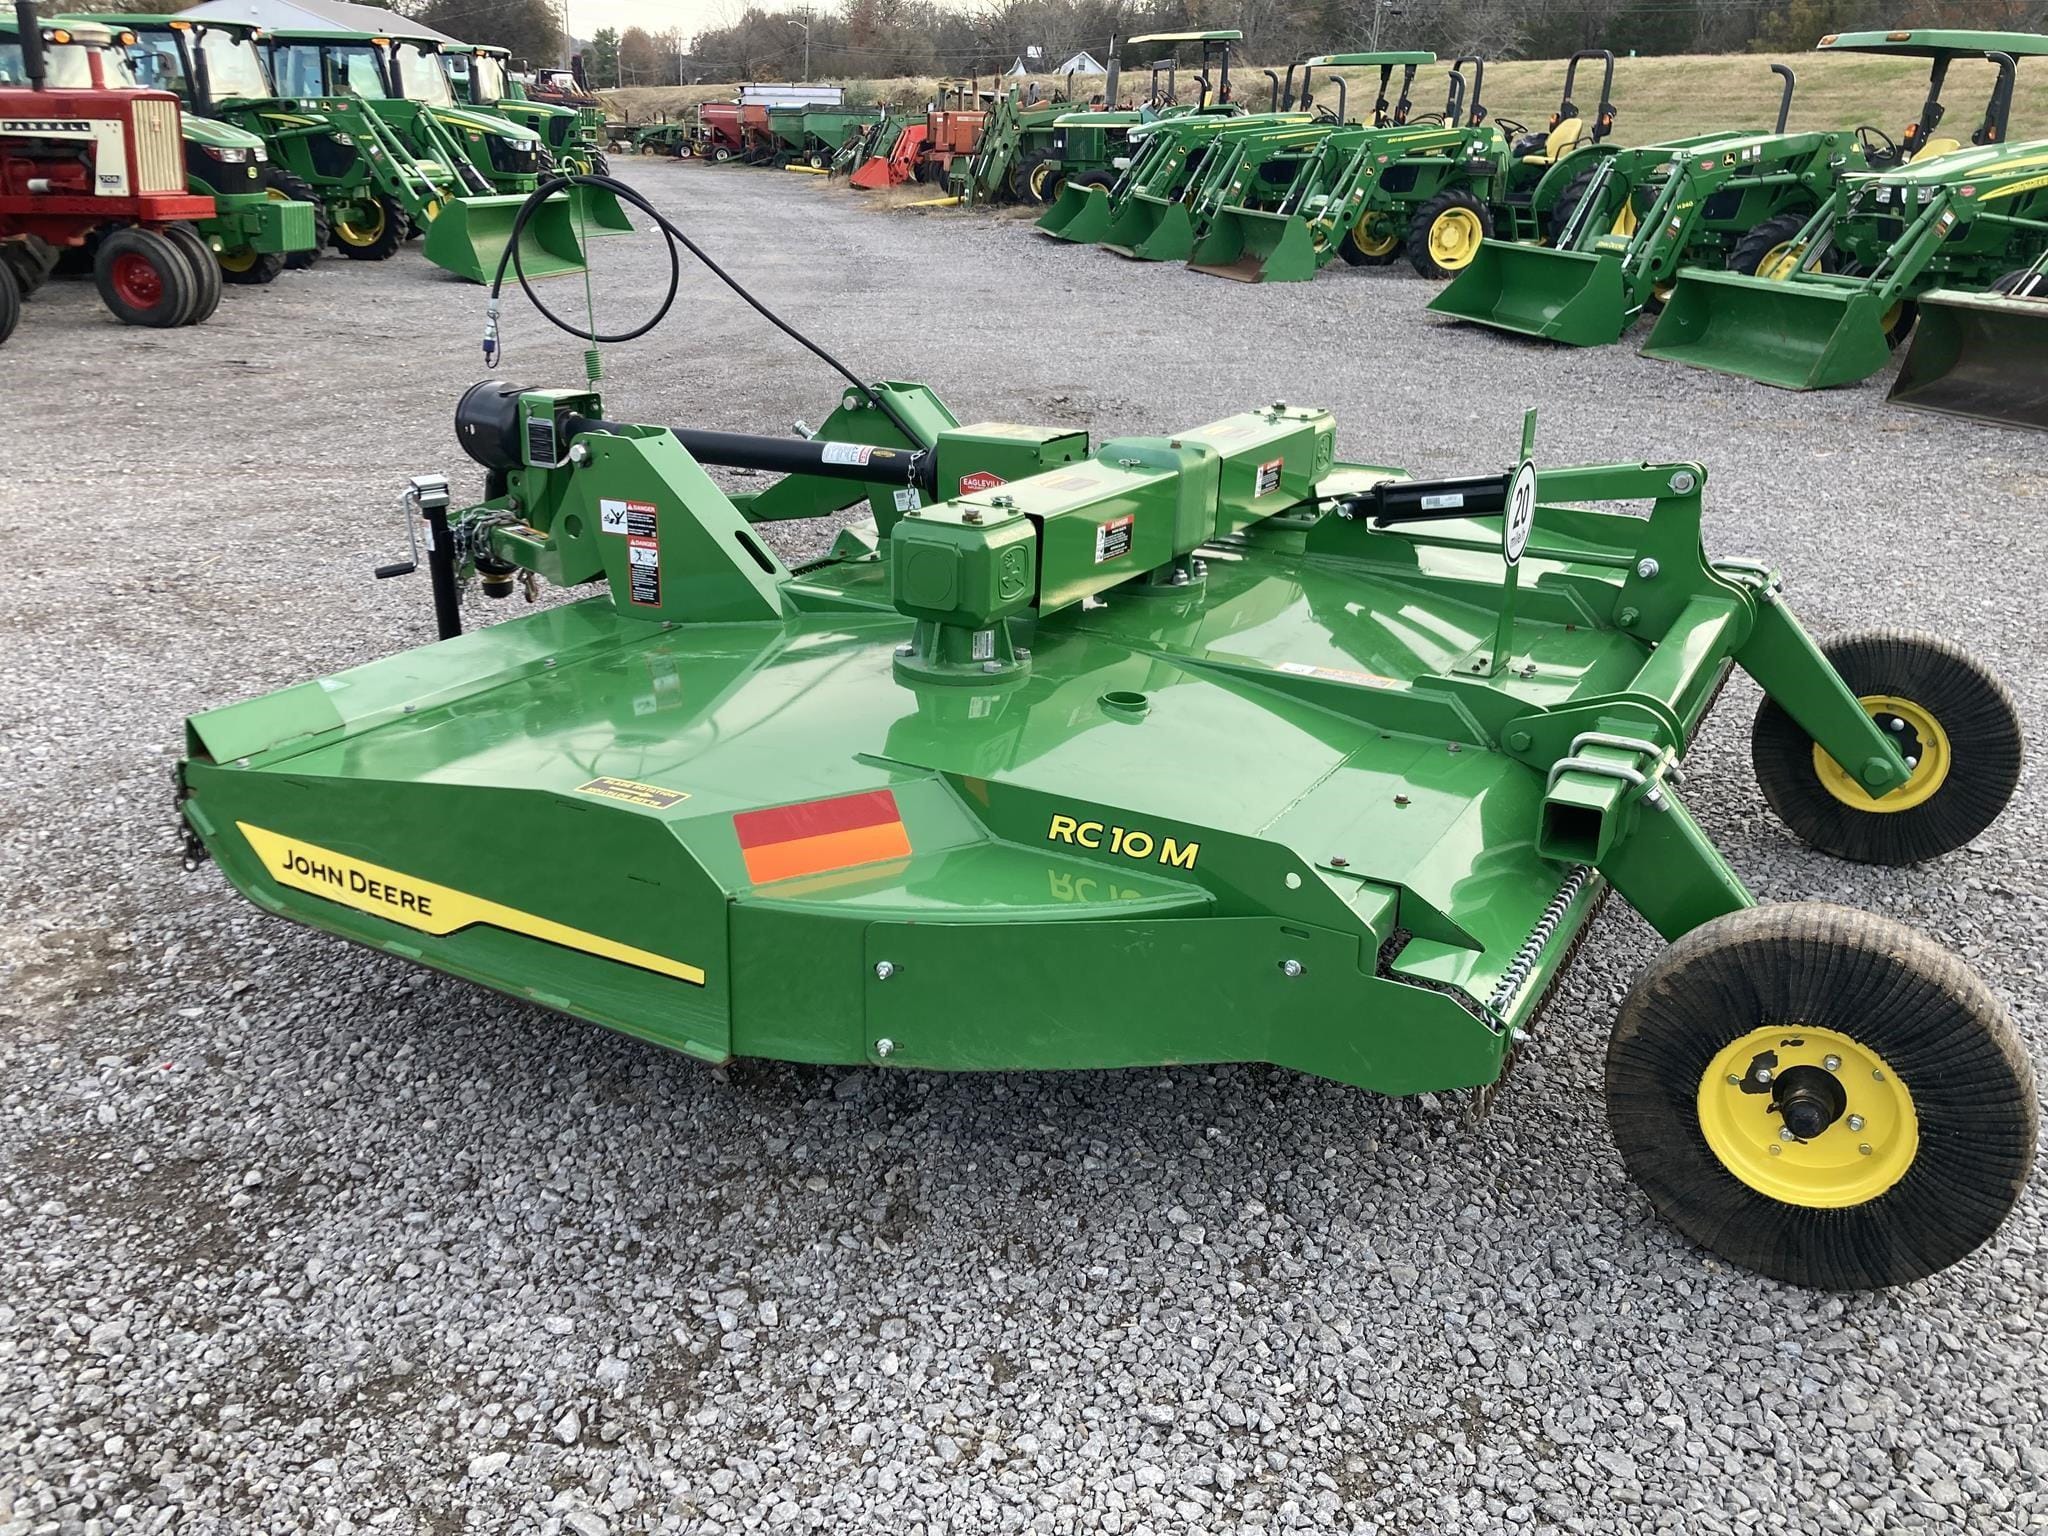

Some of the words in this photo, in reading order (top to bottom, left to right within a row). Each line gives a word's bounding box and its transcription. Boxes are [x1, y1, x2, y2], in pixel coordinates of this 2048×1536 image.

[633, 504, 656, 512] DANGER
[1512, 483, 1530, 529] 20
[635, 540, 657, 548] DANGER
[1048, 813, 1105, 849] RC
[1110, 825, 1154, 858] 10
[1159, 837, 1200, 870] M
[282, 850, 344, 888] JOHN
[350, 870, 433, 917] DEERE
